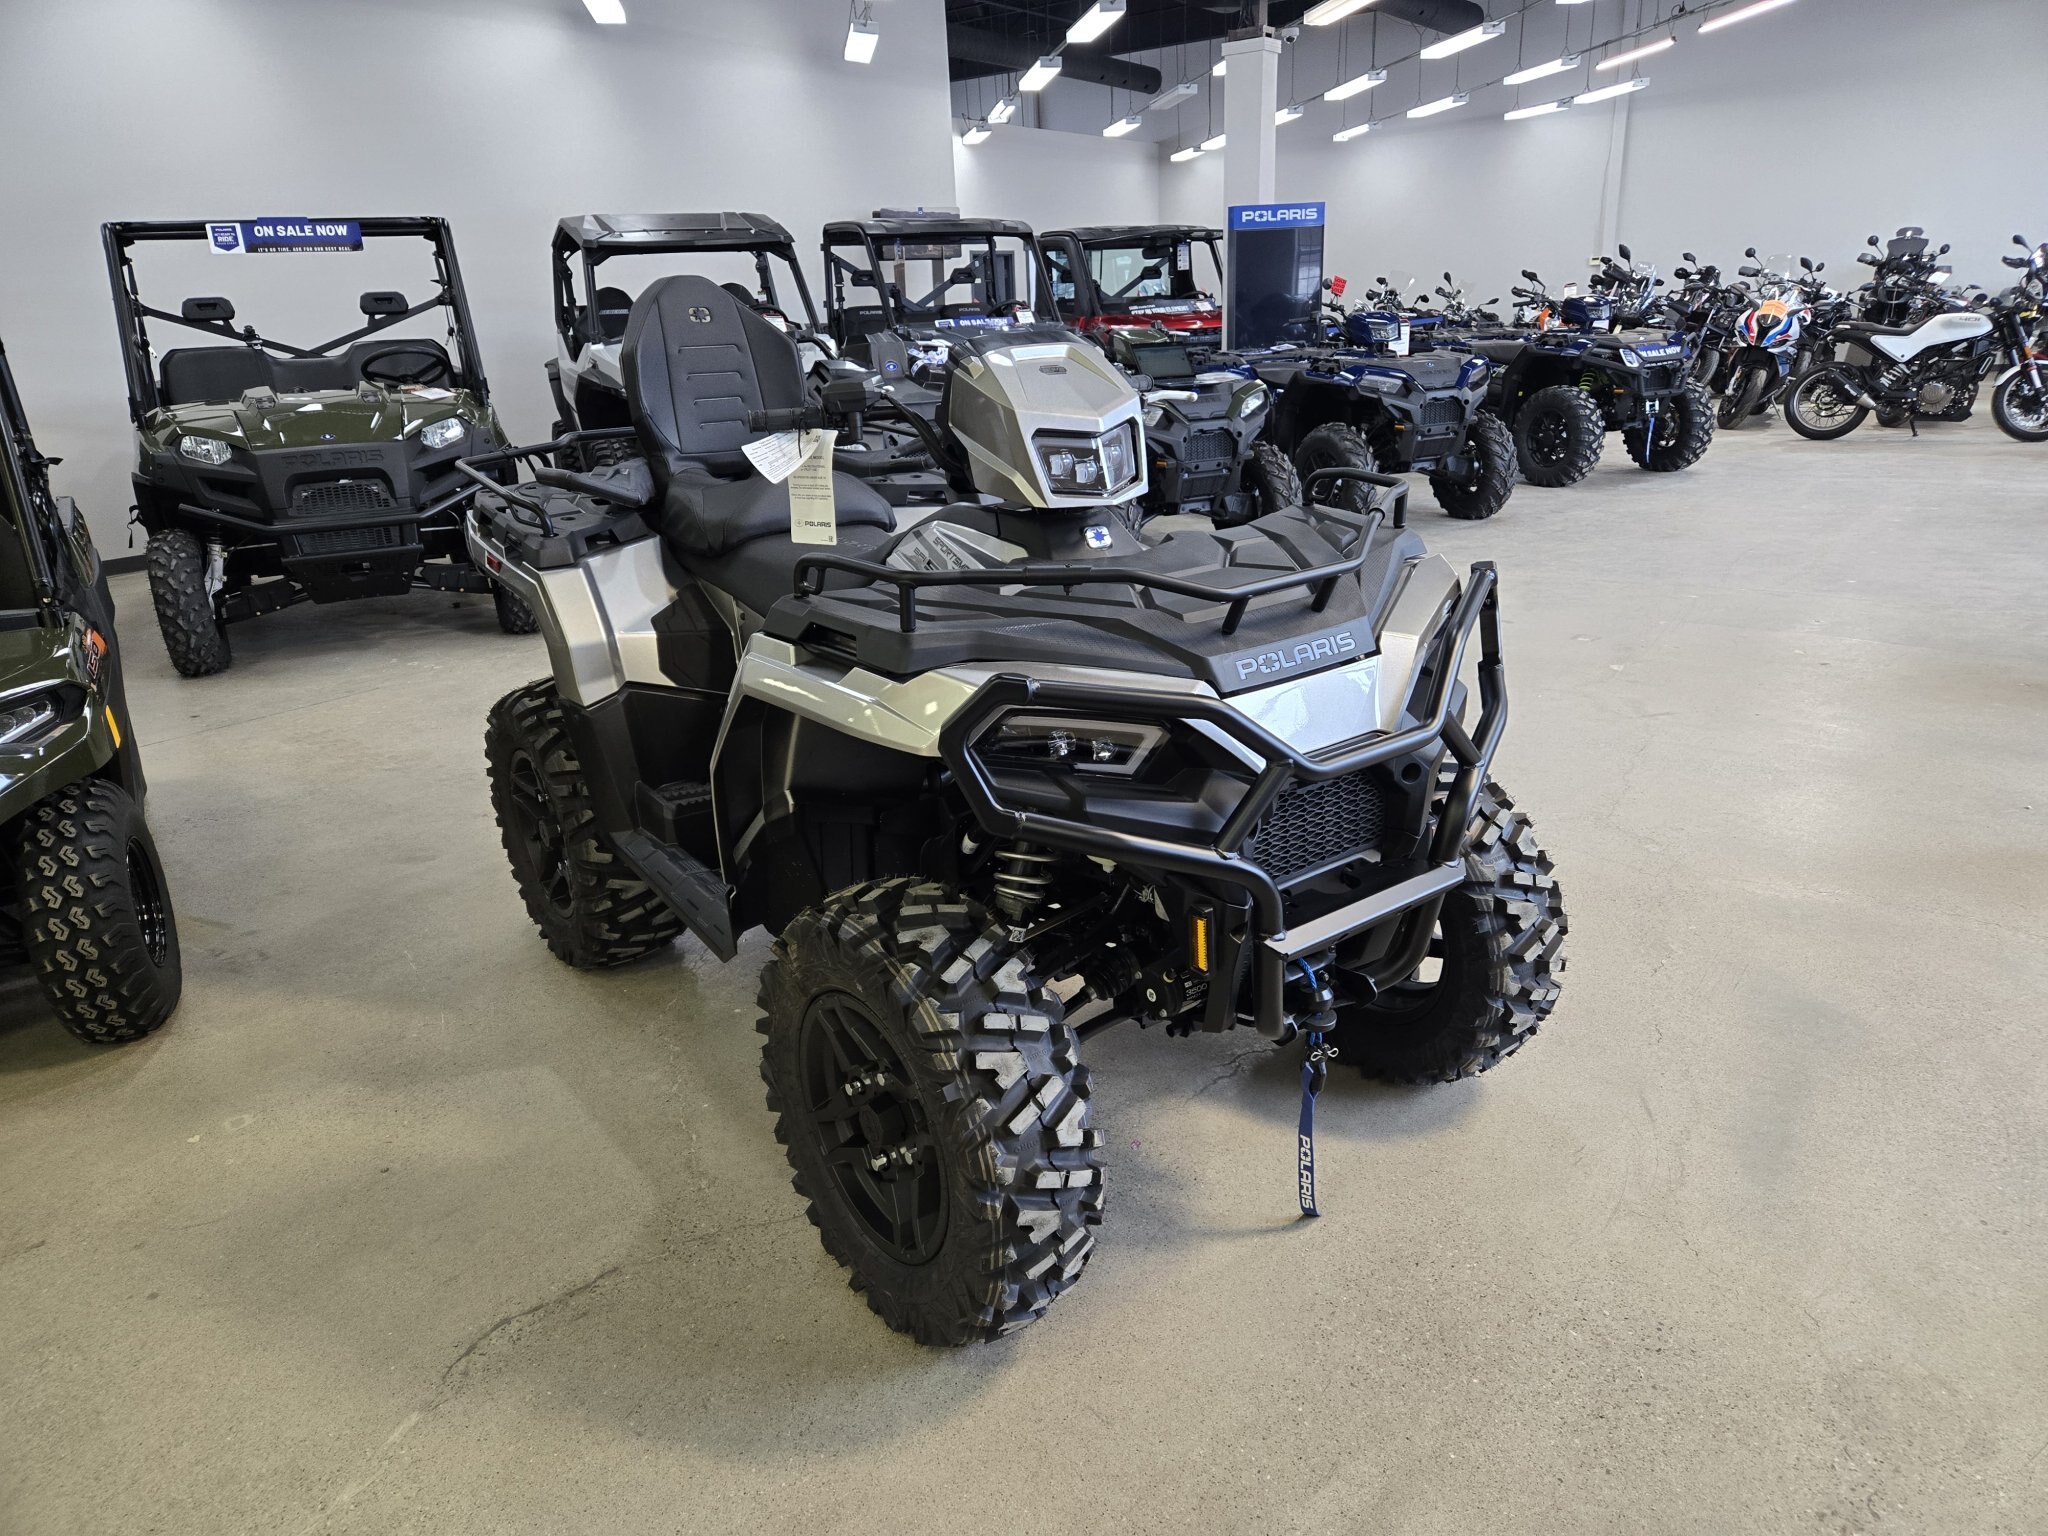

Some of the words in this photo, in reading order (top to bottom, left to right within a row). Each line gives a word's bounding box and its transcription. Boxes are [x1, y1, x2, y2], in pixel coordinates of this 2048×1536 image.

[1241, 208, 1318, 223] POLARIS
[253, 225, 274, 237] ON
[276, 225, 314, 237] SALE
[316, 224, 348, 236] NOW
[1647, 348, 1666, 357] SALE
[1665, 346, 1681, 355] NOW
[281, 449, 384, 466] POLARIS
[804, 520, 832, 528] POLARIS
[1235, 631, 1357, 680] POLARIS
[1300, 1134, 1314, 1209] POLARIS
